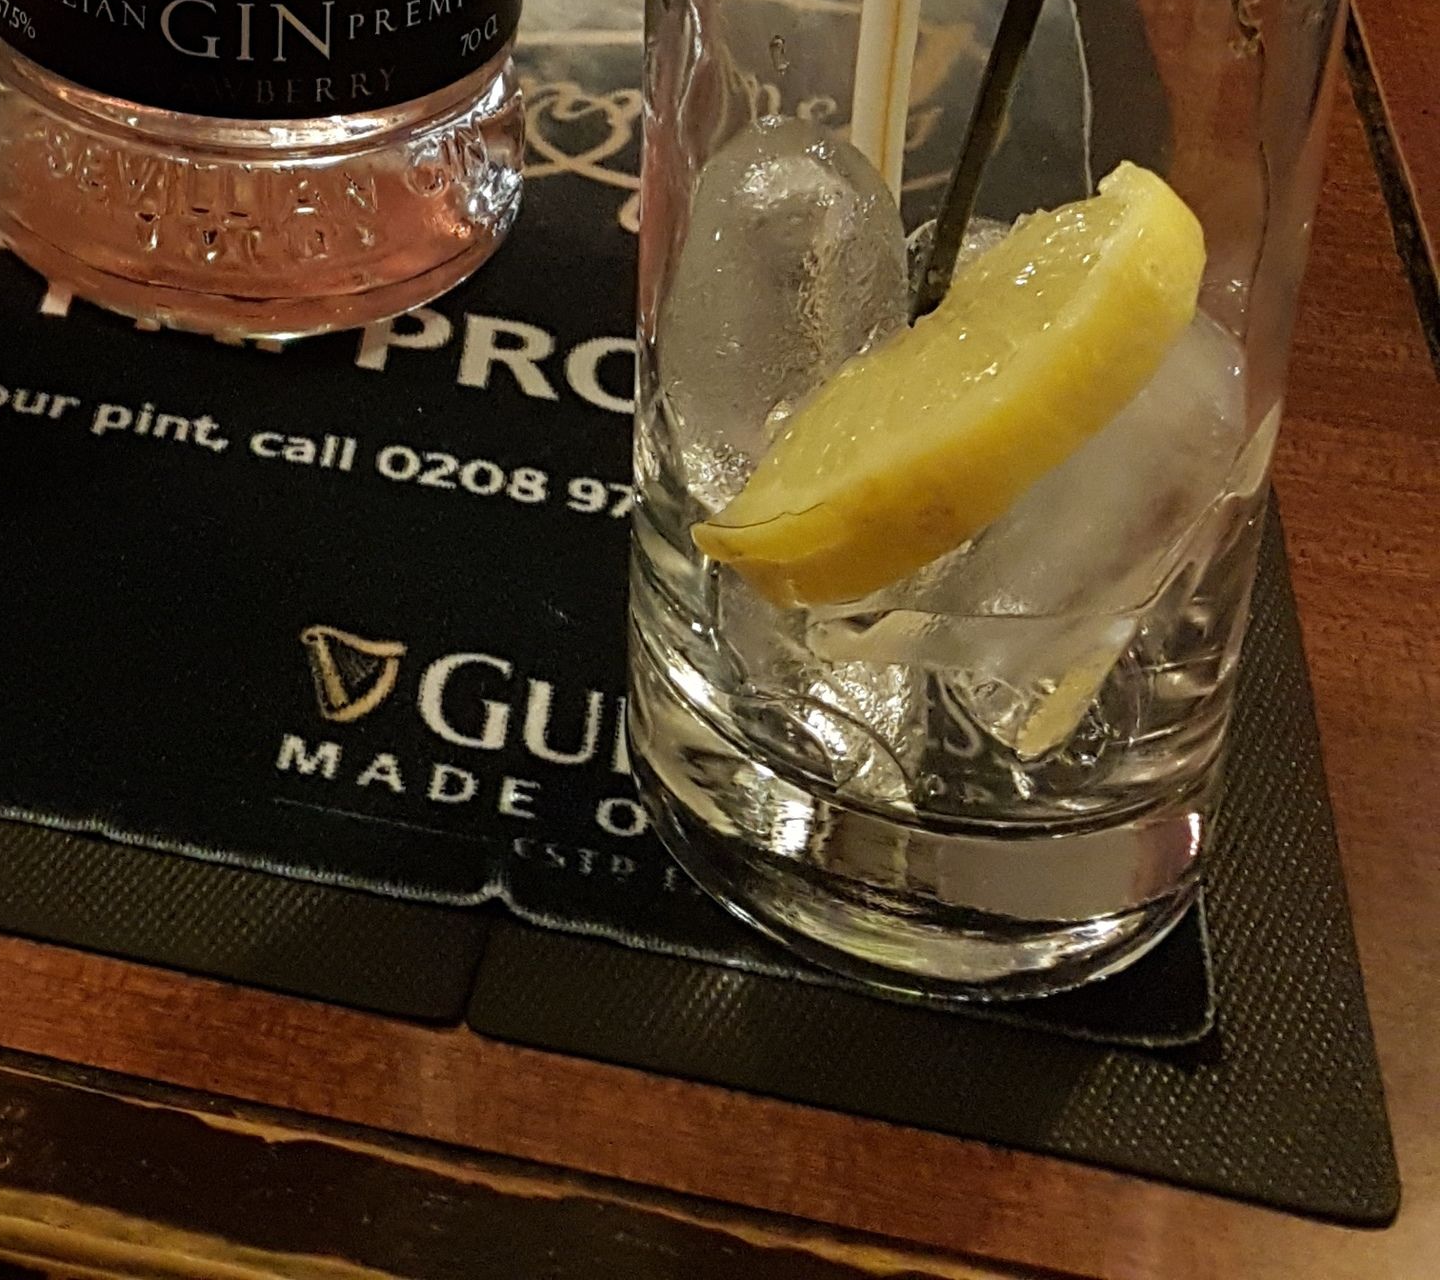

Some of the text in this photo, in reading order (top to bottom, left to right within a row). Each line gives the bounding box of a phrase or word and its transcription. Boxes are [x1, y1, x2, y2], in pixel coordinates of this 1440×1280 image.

[249, 429, 358, 473] call
[375, 444, 549, 504] 0208
[275, 733, 542, 820] MADE
